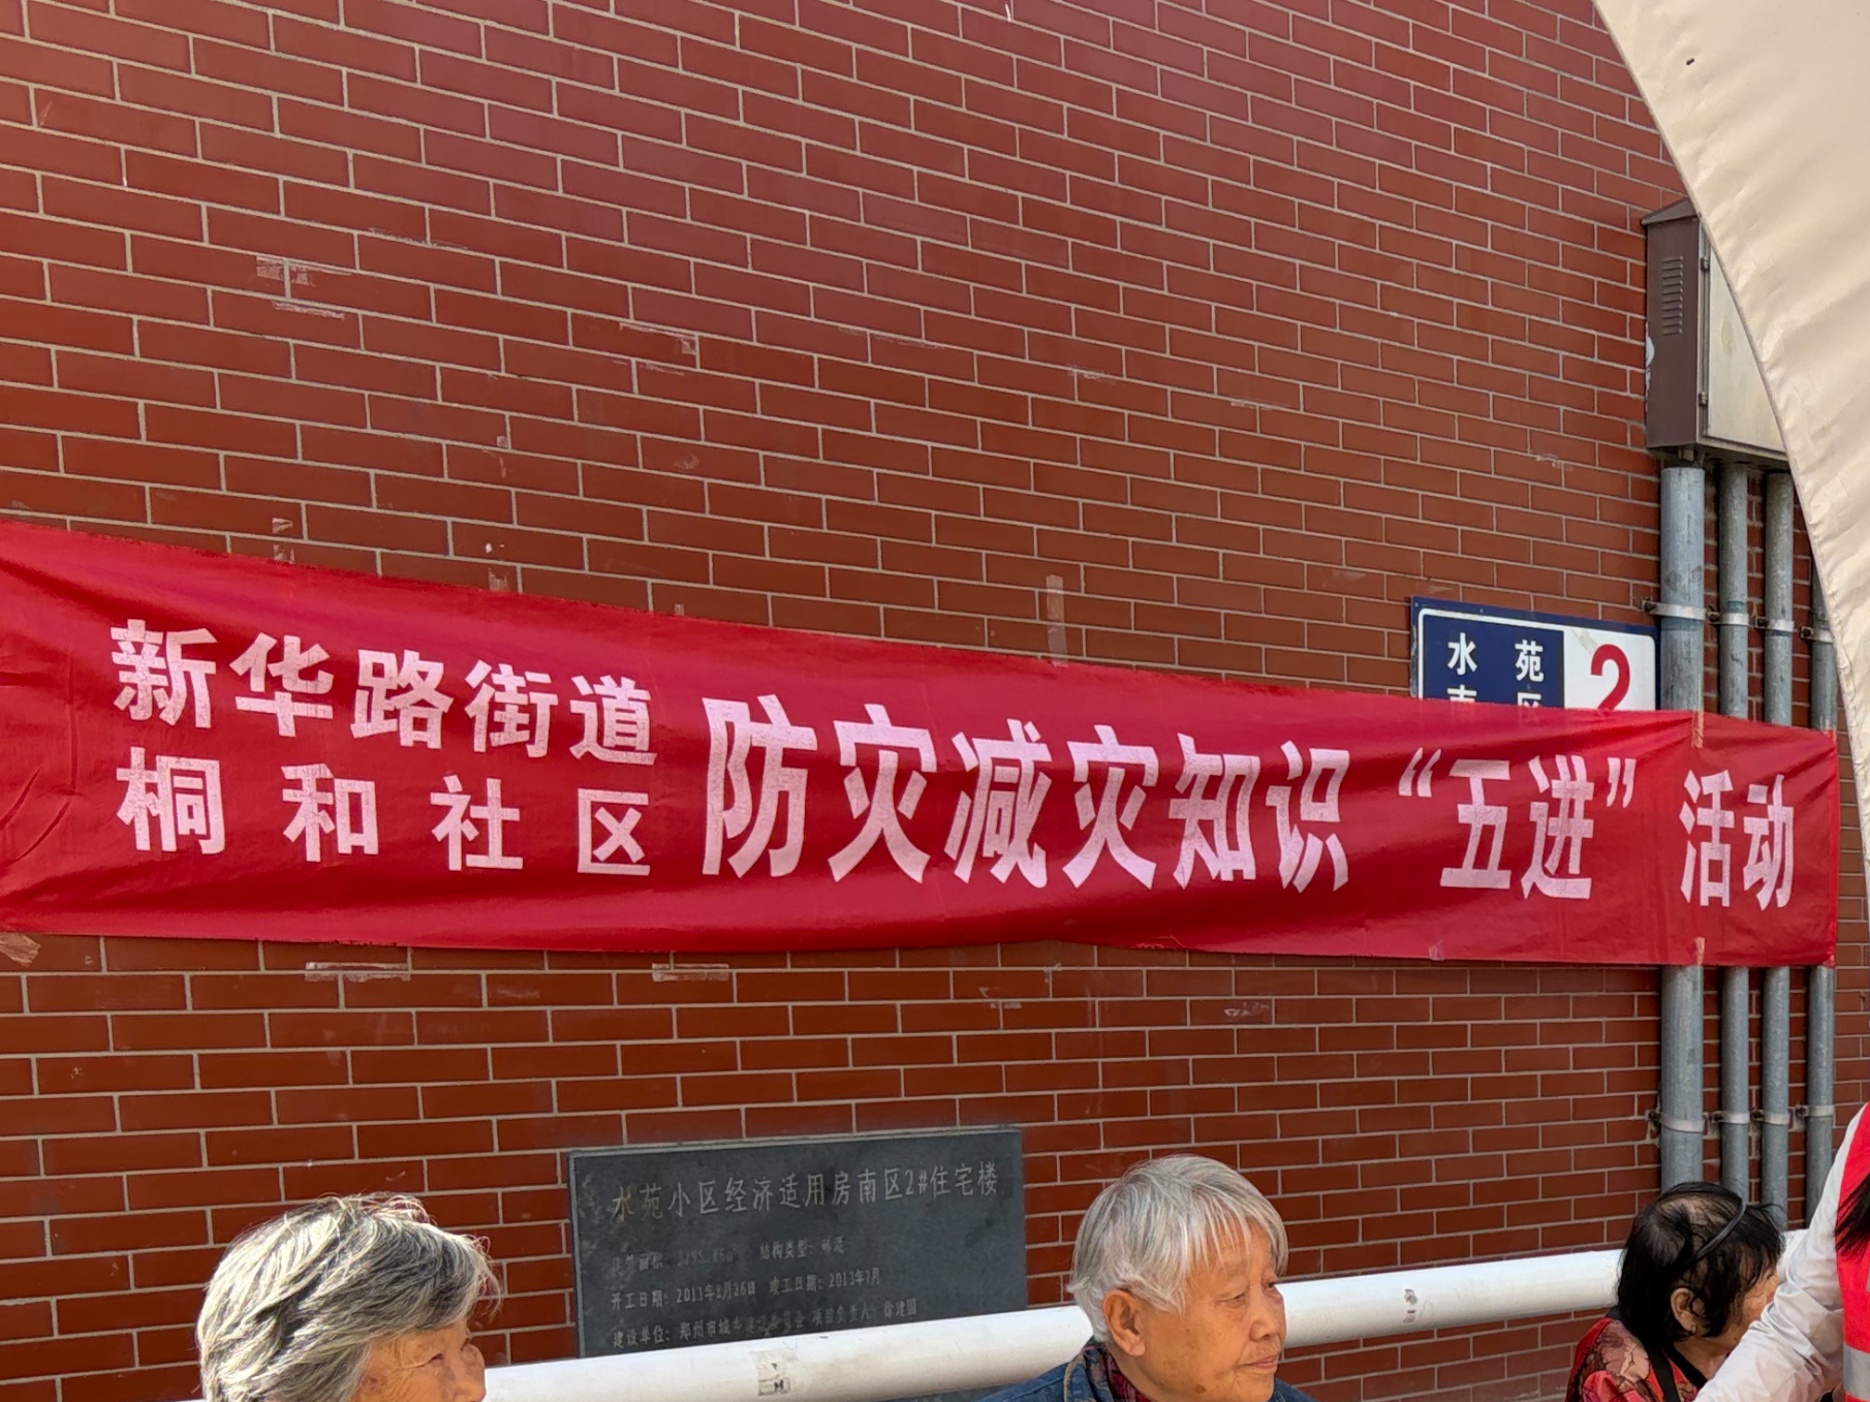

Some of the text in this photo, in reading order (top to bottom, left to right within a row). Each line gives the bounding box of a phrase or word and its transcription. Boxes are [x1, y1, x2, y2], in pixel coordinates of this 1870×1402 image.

[1447, 632, 1545, 683] 水苑
[1590, 643, 1632, 711] 2
[110, 618, 657, 767] 新华路街道
[115, 746, 652, 878] 桐和社区
[610, 1160, 999, 1222] 水苑小区经济适用房南区2#住宅楼
